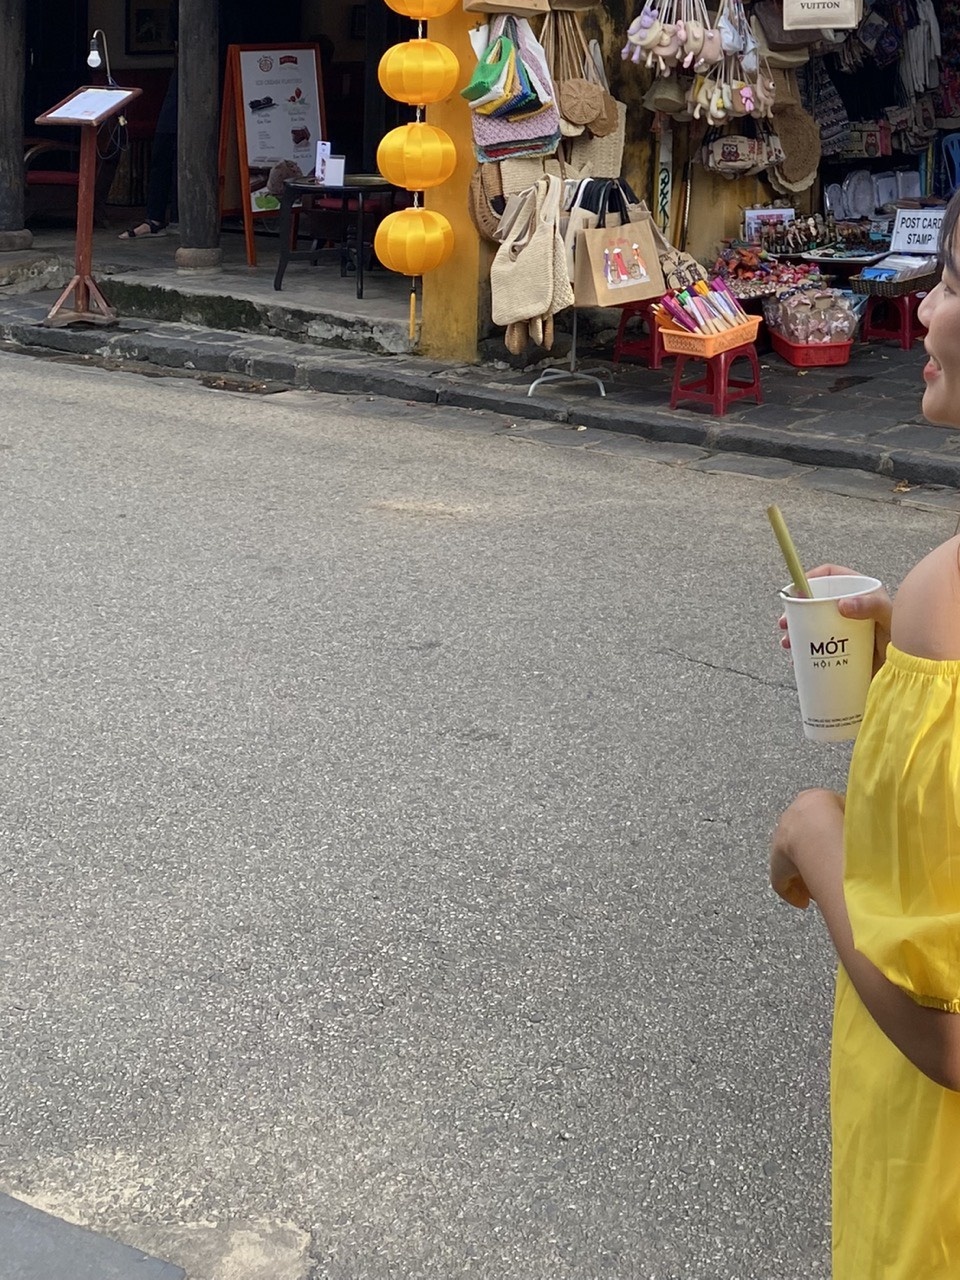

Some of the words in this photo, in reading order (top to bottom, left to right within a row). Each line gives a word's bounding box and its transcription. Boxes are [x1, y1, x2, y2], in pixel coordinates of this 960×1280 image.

[800, 1, 841, 10] VUITTON
[900, 217, 921, 229] POST
[922, 217, 943, 229] CARD
[906, 233, 933, 245] STAMP
[809, 636, 849, 656] MÓT
[813, 660, 831, 669] HỘI
[835, 659, 849, 667] AN
